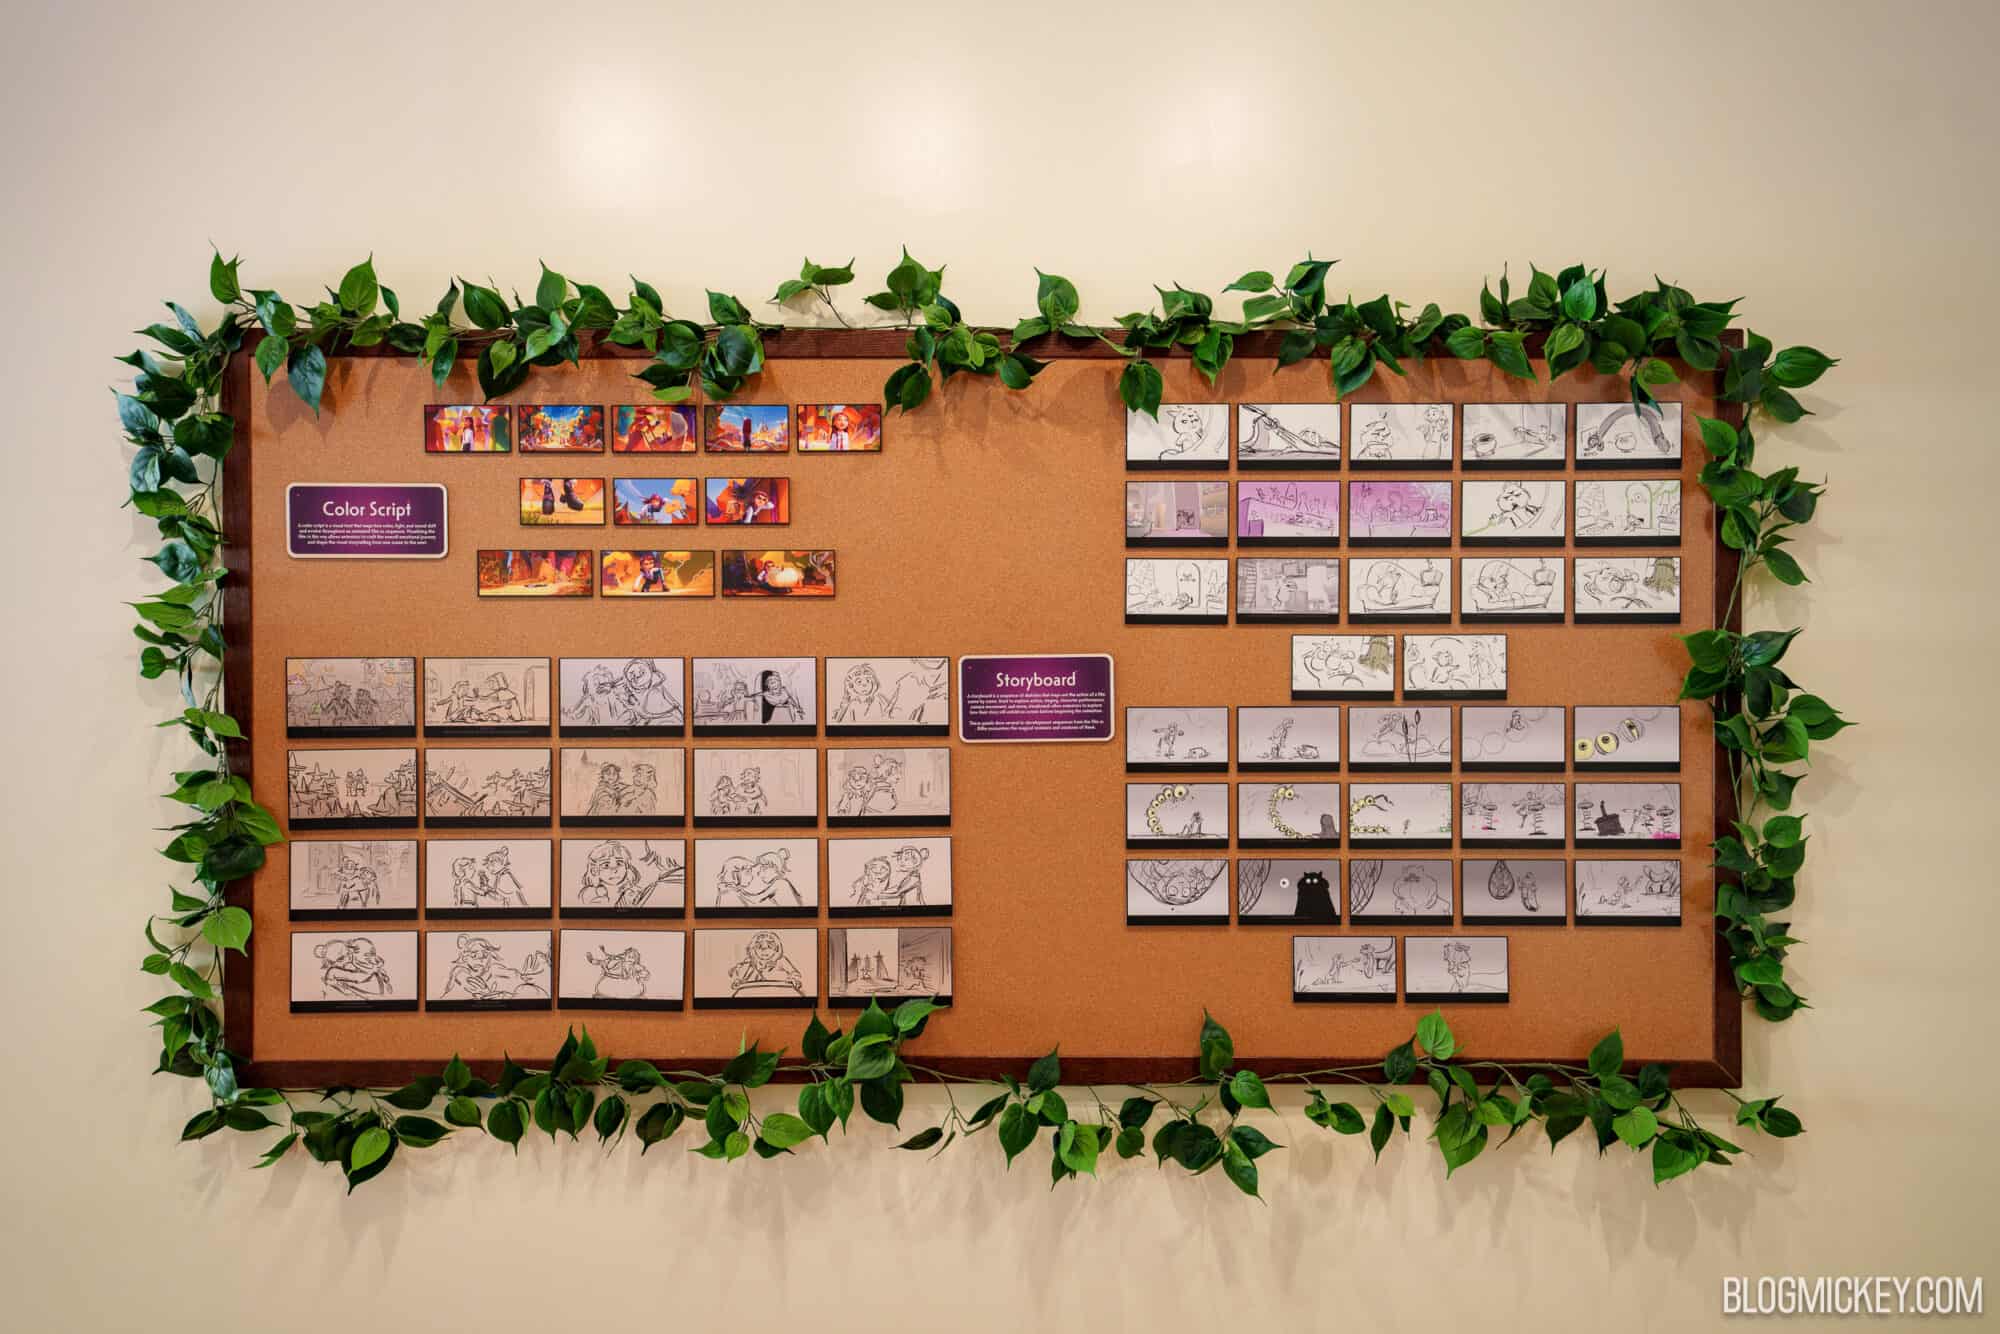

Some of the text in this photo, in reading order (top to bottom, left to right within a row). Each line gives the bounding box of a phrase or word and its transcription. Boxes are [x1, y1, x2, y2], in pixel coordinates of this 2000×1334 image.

[323, 501, 412, 521] Color Script
[996, 671, 1076, 691] Storyboard
